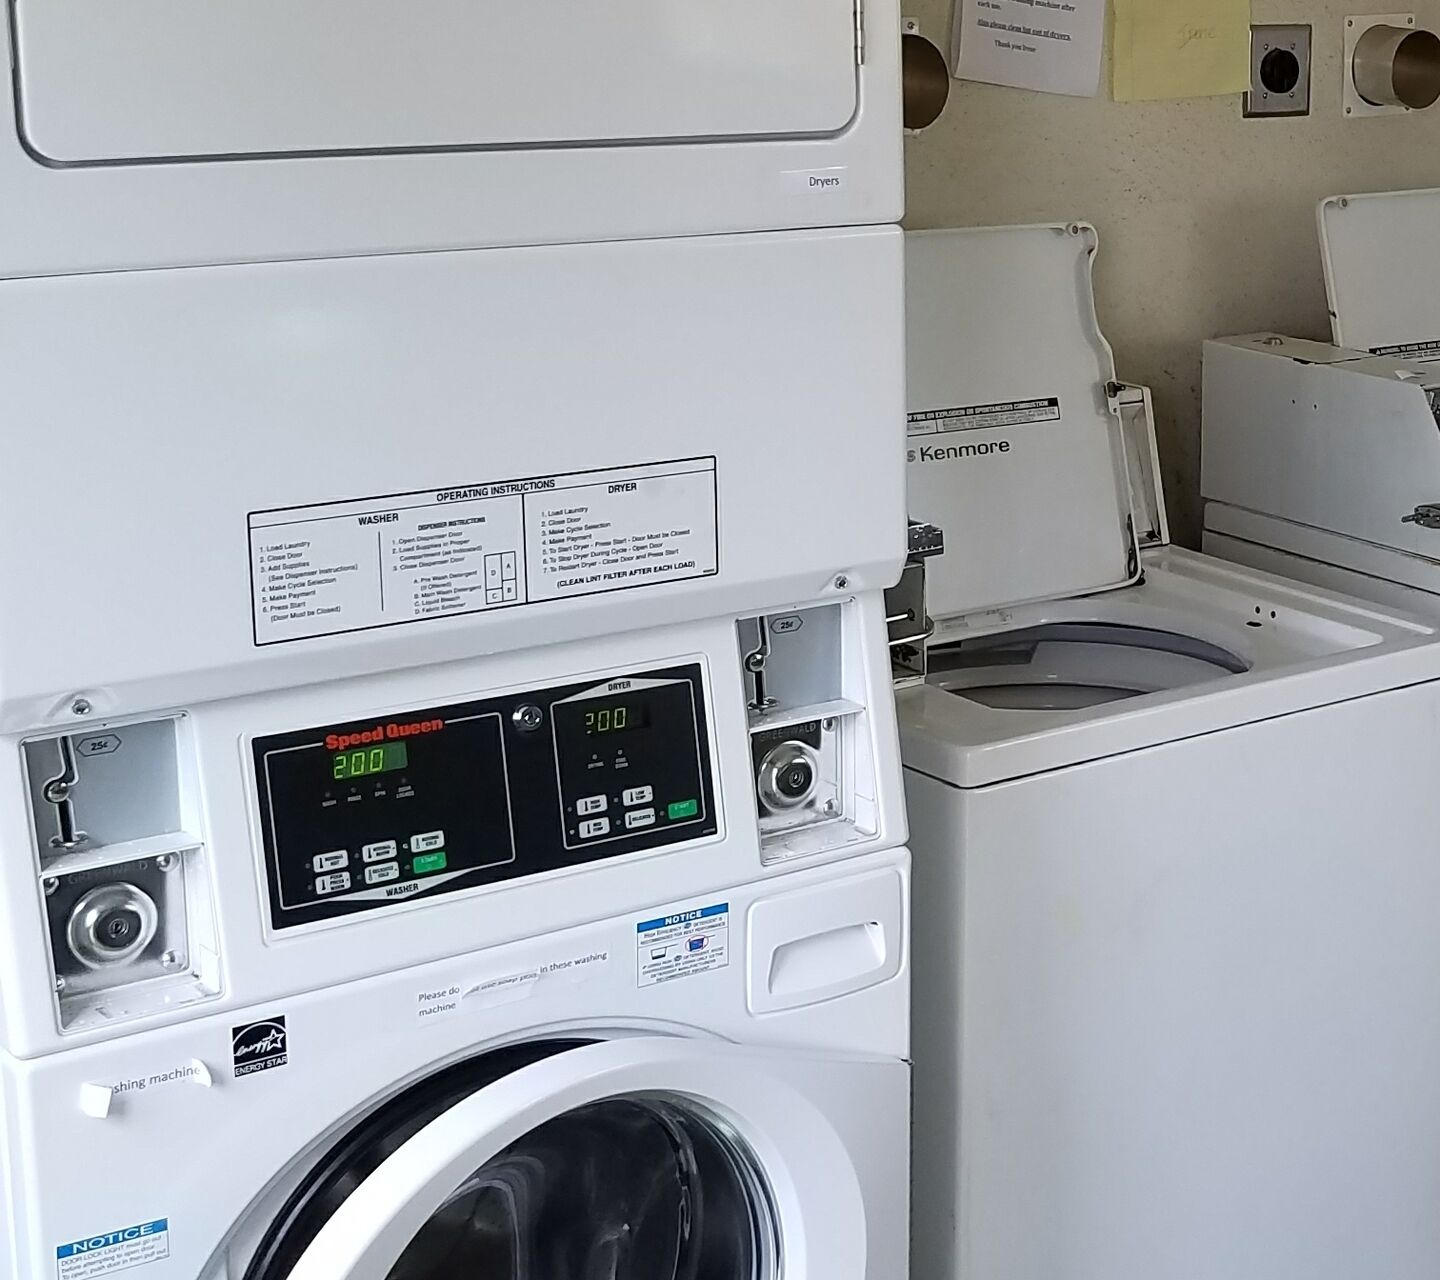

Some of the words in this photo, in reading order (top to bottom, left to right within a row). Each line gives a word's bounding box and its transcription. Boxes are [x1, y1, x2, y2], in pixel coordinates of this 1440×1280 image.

[810, 177, 839, 188] Dryers
[920, 441, 1009, 462] Kenmore
[437, 488, 488, 502] OPERATING
[491, 479, 555, 496] INSTRUCTIONS
[608, 483, 636, 493] DRYER
[358, 513, 399, 525] WASHER
[565, 507, 588, 515] Laundry
[549, 518, 565, 526] Close
[585, 522, 610, 530] Selection
[284, 542, 310, 550] Laundry
[567, 534, 591, 543] Payment
[574, 543, 589, 551] Dryer
[671, 529, 690, 537] Closed
[573, 552, 589, 561] Dryer
[591, 549, 610, 559] During
[611, 547, 627, 556] Cycle
[632, 544, 648, 552] Open
[285, 570, 317, 580] Dispenser
[319, 564, 358, 574] Instructions)
[559, 562, 580, 571] Restart
[581, 561, 597, 569] Dryer
[307, 578, 336, 586] Selection
[557, 576, 585, 588] (CLEAN
[586, 575, 601, 583] LINT
[603, 571, 627, 580] FILTER
[629, 568, 652, 577] AFTER
[654, 564, 672, 573] EACH
[674, 561, 695, 570] LOAD)
[288, 590, 315, 599] Payment
[316, 606, 340, 615] Closed)
[608, 681, 631, 691] DRYER
[325, 727, 383, 750] Speed
[386, 719, 444, 738] Queen
[334, 749, 384, 779] 200
[386, 882, 419, 898] WASHER
[665, 910, 702, 925] NOTICE
[419, 991, 446, 1002] Please
[449, 986, 459, 995] do
[550, 961, 572, 971] these
[575, 952, 608, 966] washing
[419, 1002, 456, 1017] machine
[236, 1061, 265, 1075] ENERGY
[267, 1056, 288, 1067] STAR
[110, 1076, 146, 1095] shing
[150, 1066, 200, 1085] machine
[73, 1223, 154, 1254] NOTICE
[62, 1257, 82, 1266] DOOR
[83, 1251, 102, 1261] LOCK
[104, 1246, 124, 1255] LIGHT
[62, 1264, 81, 1273] before
[83, 1256, 115, 1268] attempting
[125, 1249, 139, 1257] open
[90, 1265, 105, 1274] push
[129, 1254, 143, 1262] then
[144, 1251, 155, 1259] pull
